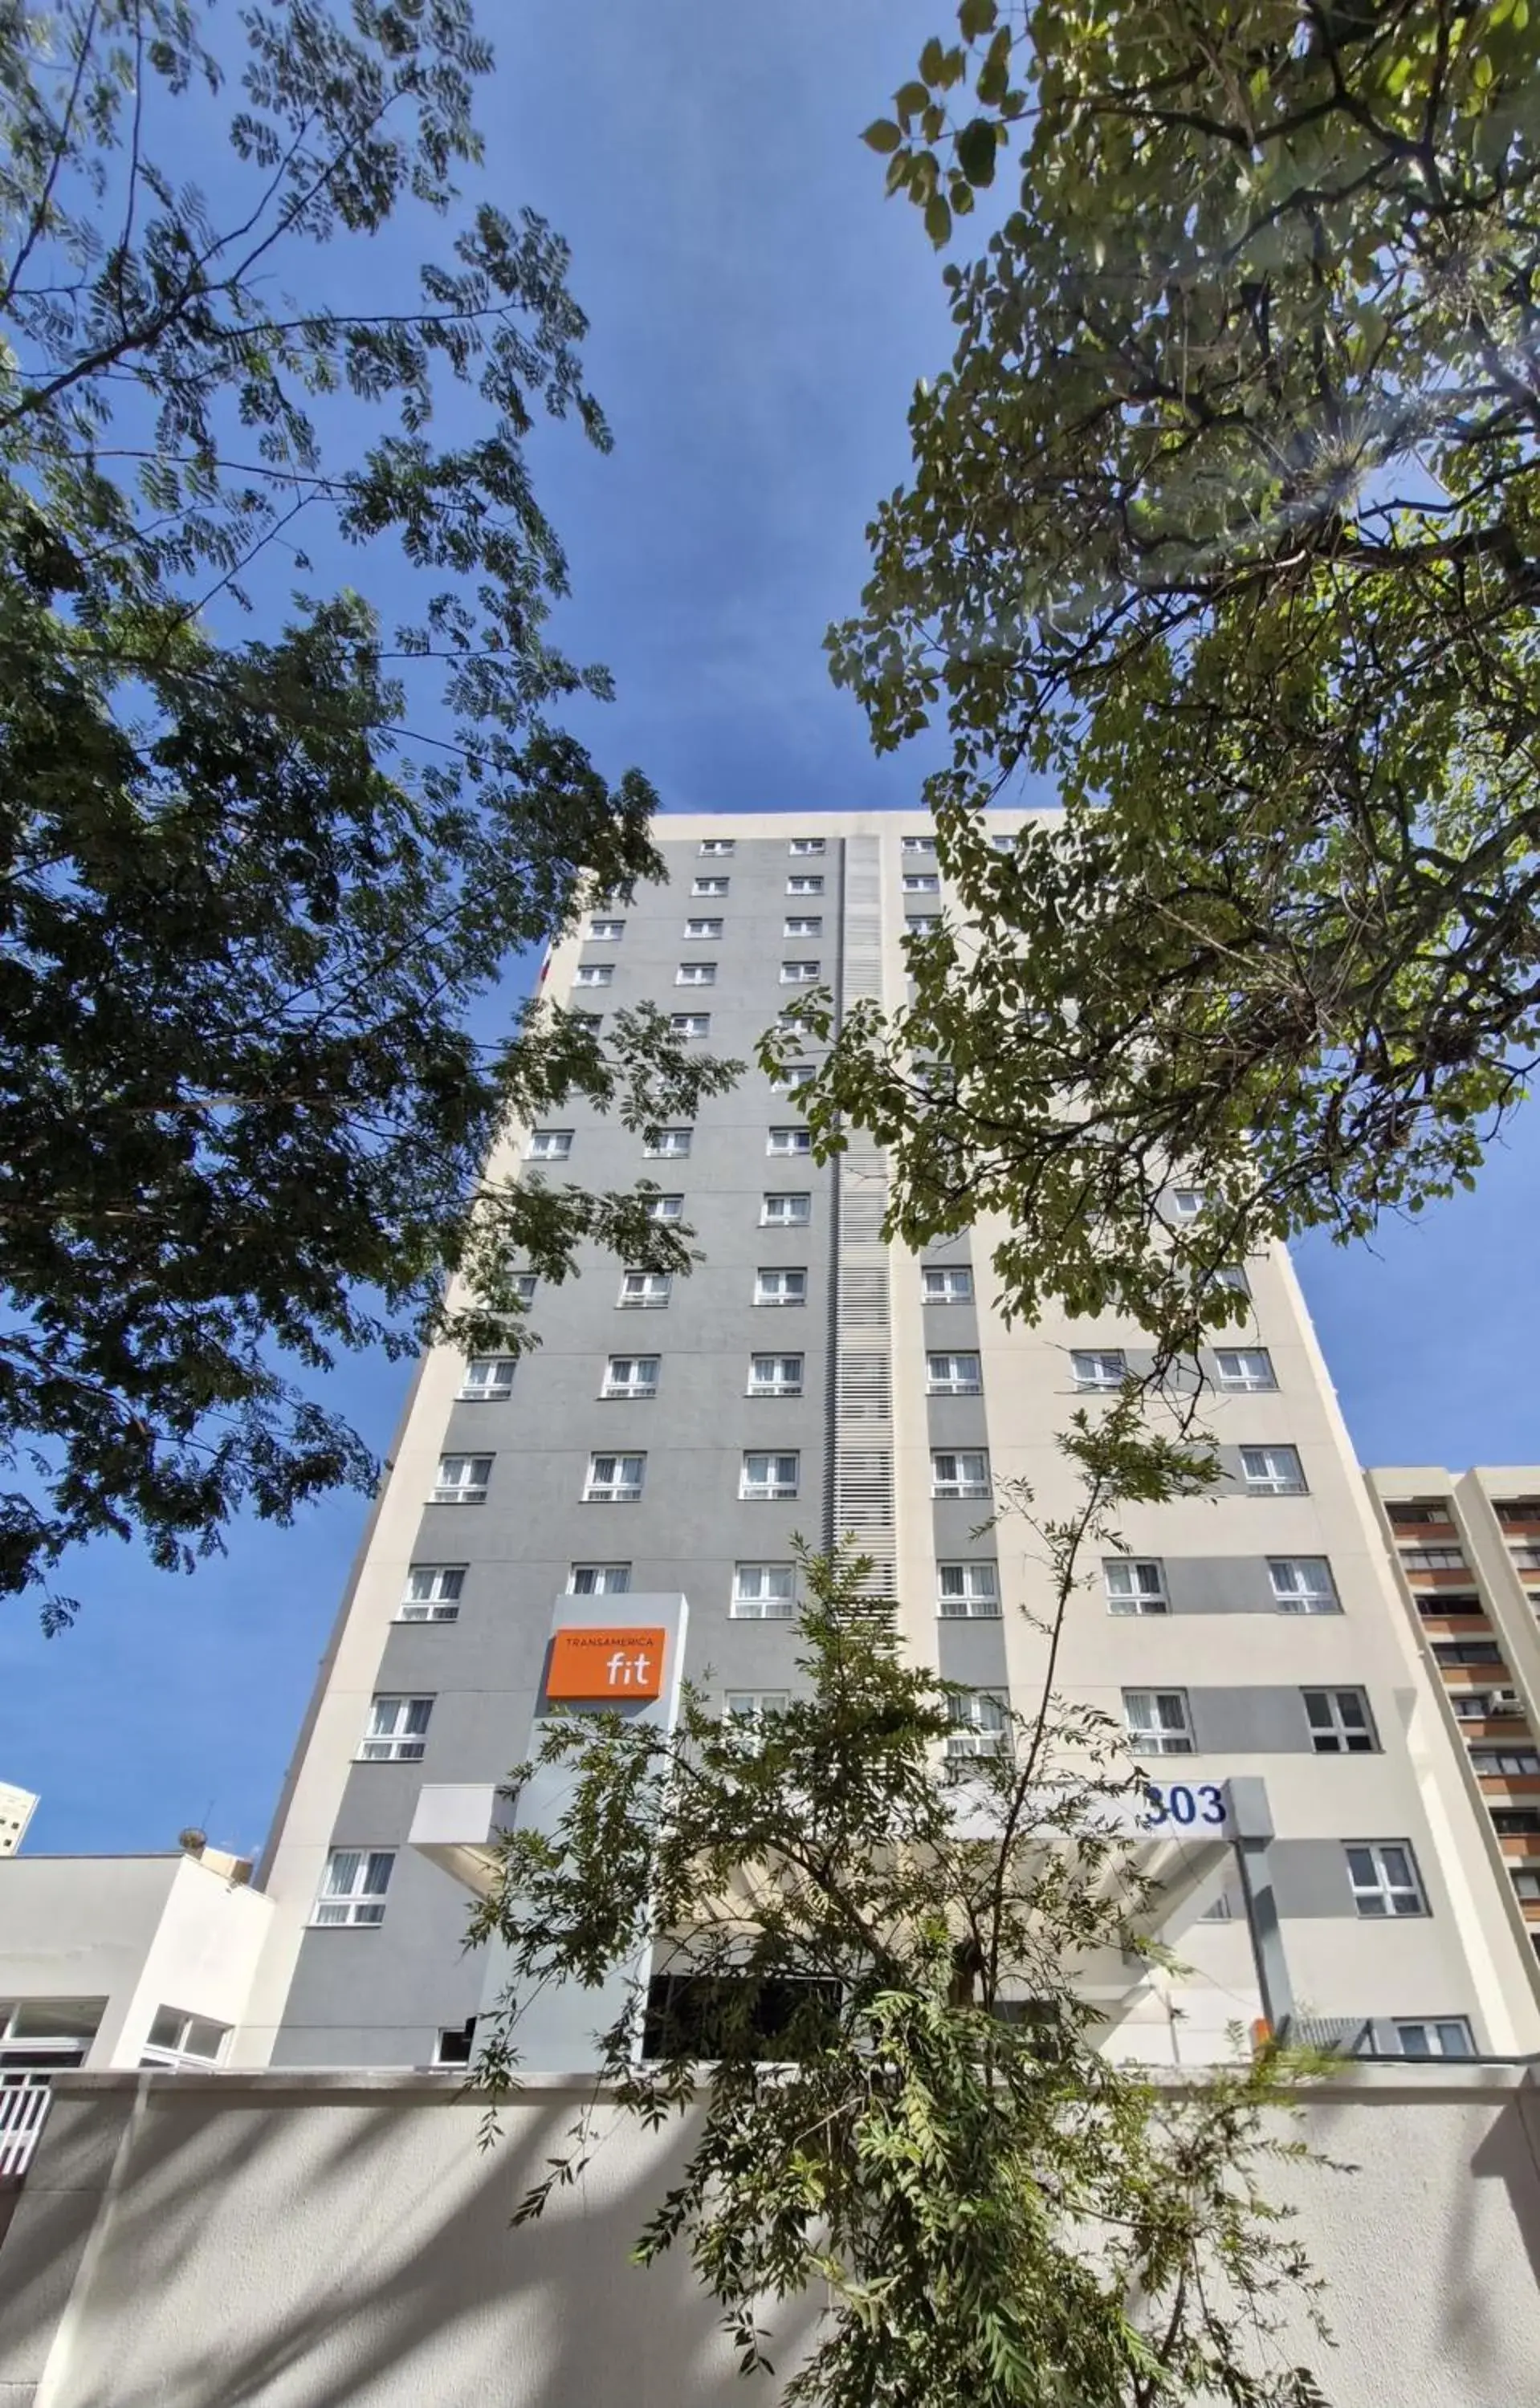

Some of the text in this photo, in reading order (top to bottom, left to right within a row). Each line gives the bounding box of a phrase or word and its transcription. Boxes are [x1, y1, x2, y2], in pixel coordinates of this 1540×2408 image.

[566, 1637, 654, 1646] TRANSAMERICA
[606, 1652, 650, 1685] fit
[1144, 1786, 1226, 1824] 303
